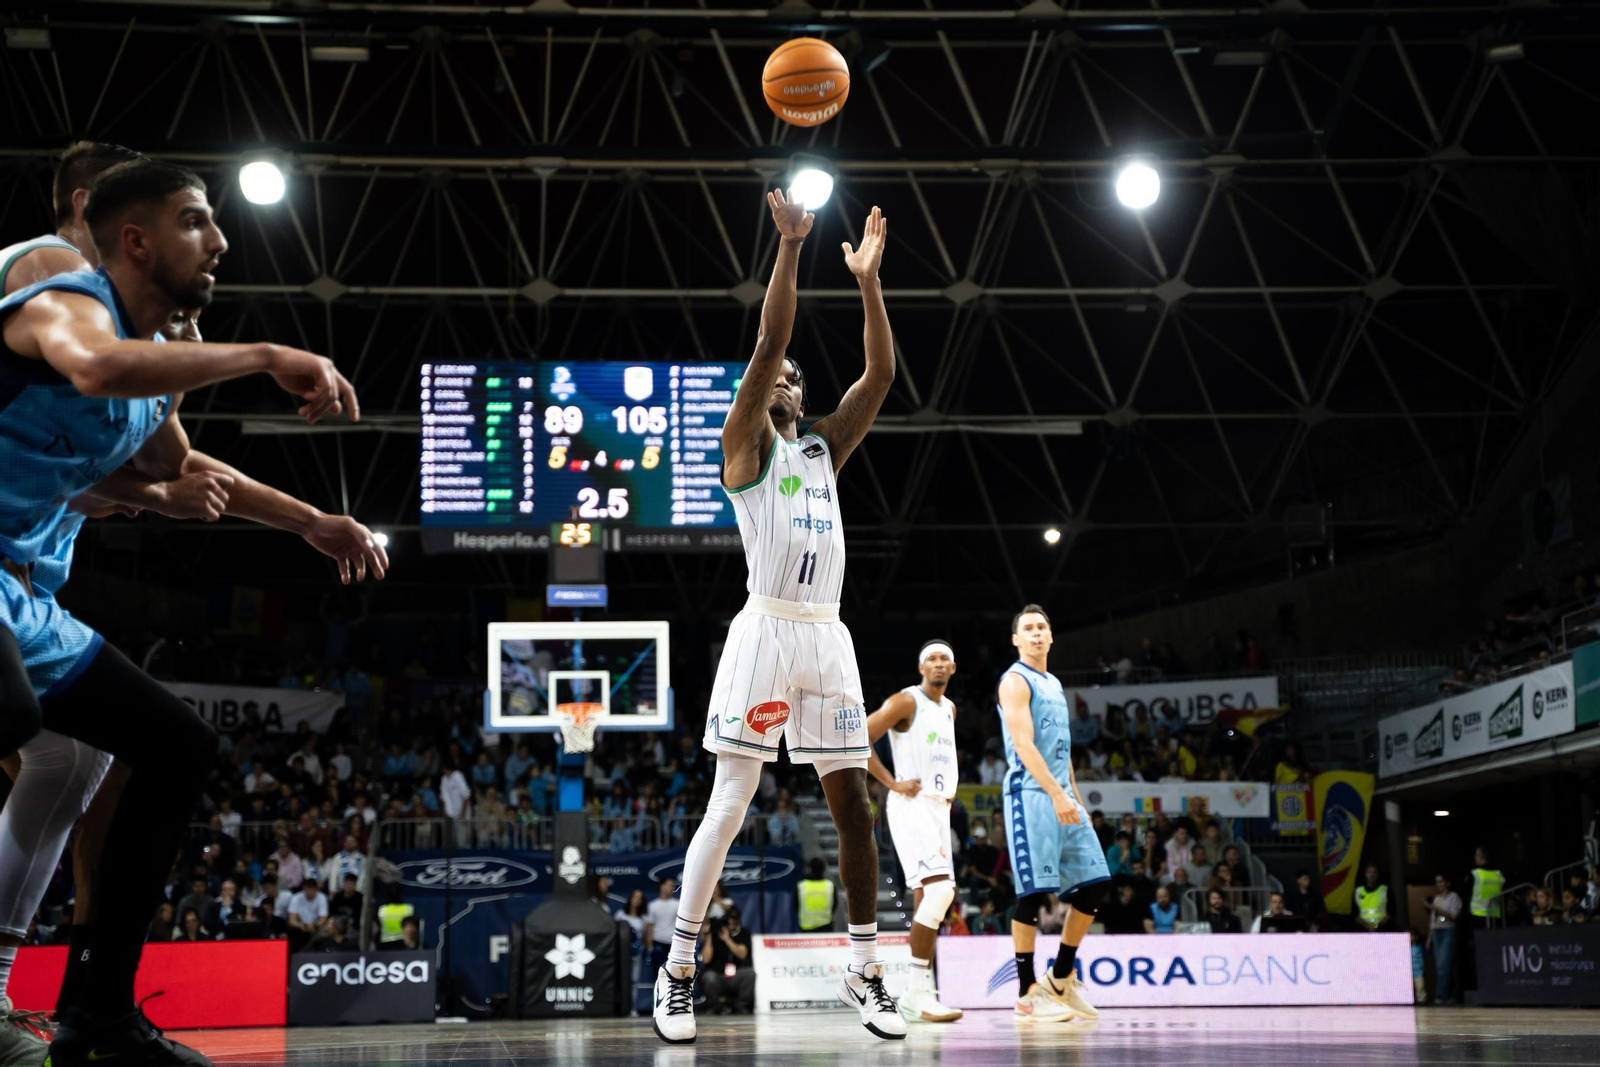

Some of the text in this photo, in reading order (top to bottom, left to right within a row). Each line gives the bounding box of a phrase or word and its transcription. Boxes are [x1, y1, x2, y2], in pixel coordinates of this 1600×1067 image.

[544, 405, 583, 434] 89
[611, 405, 668, 434] 105
[548, 446, 568, 469] 5
[594, 450, 608, 467] 4
[641, 446, 661, 469] 5
[576, 487, 629, 519] 2.5
[453, 531, 549, 551] Hesperia.c
[560, 523, 591, 544] 25
[626, 534, 742, 546] HESPERIA ANDO
[798, 550, 816, 585] 11
[1546, 686, 1568, 705] KERN
[1464, 710, 1482, 726] KERN
[935, 773, 944, 791] 6
[416, 861, 509, 885] Ford
[81, 949, 90, 961] B
[489, 935, 509, 962] F
[1501, 944, 1543, 973] IMO
[297, 956, 429, 985] endesa
[545, 987, 593, 1002] UNNIC
